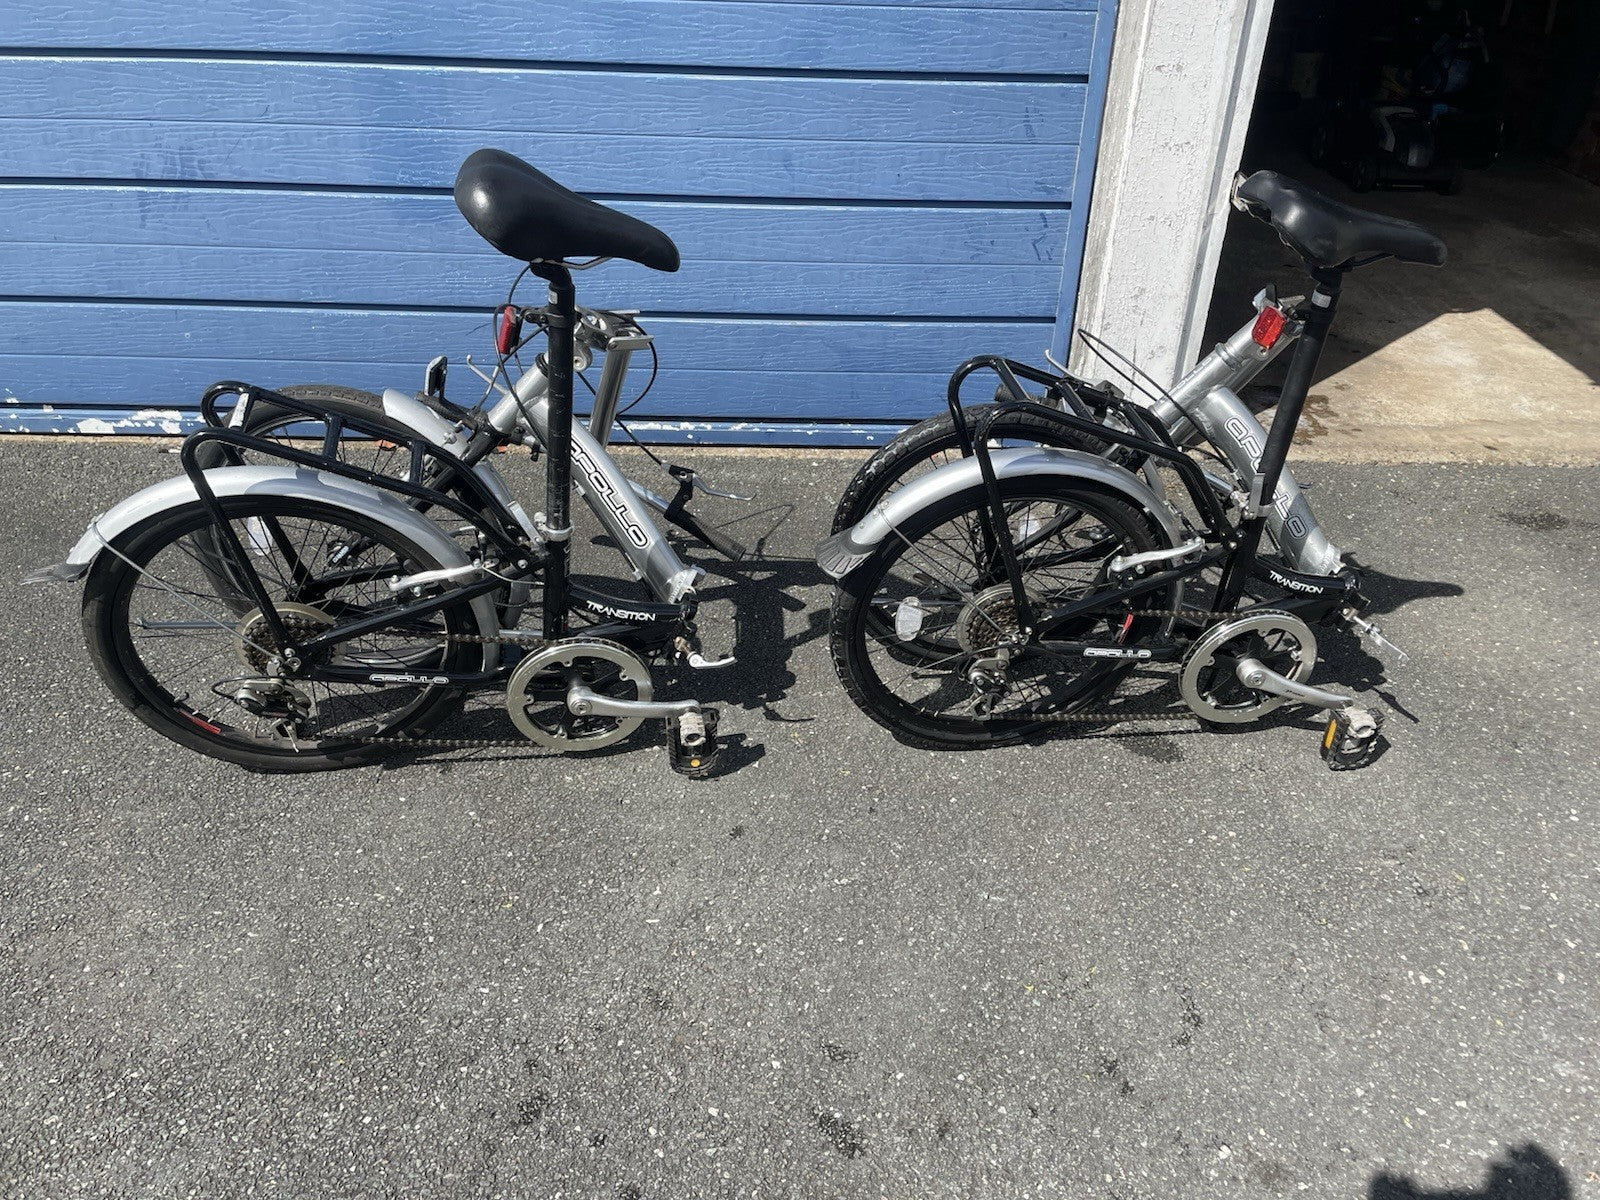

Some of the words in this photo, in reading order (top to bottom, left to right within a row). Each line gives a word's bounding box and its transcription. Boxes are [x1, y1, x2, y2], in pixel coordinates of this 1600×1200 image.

[1224, 416, 1310, 540] APLO
[1269, 570, 1324, 594] TRANSITION
[586, 600, 656, 621] TRANSITION
[369, 673, 449, 684] APOLLO
